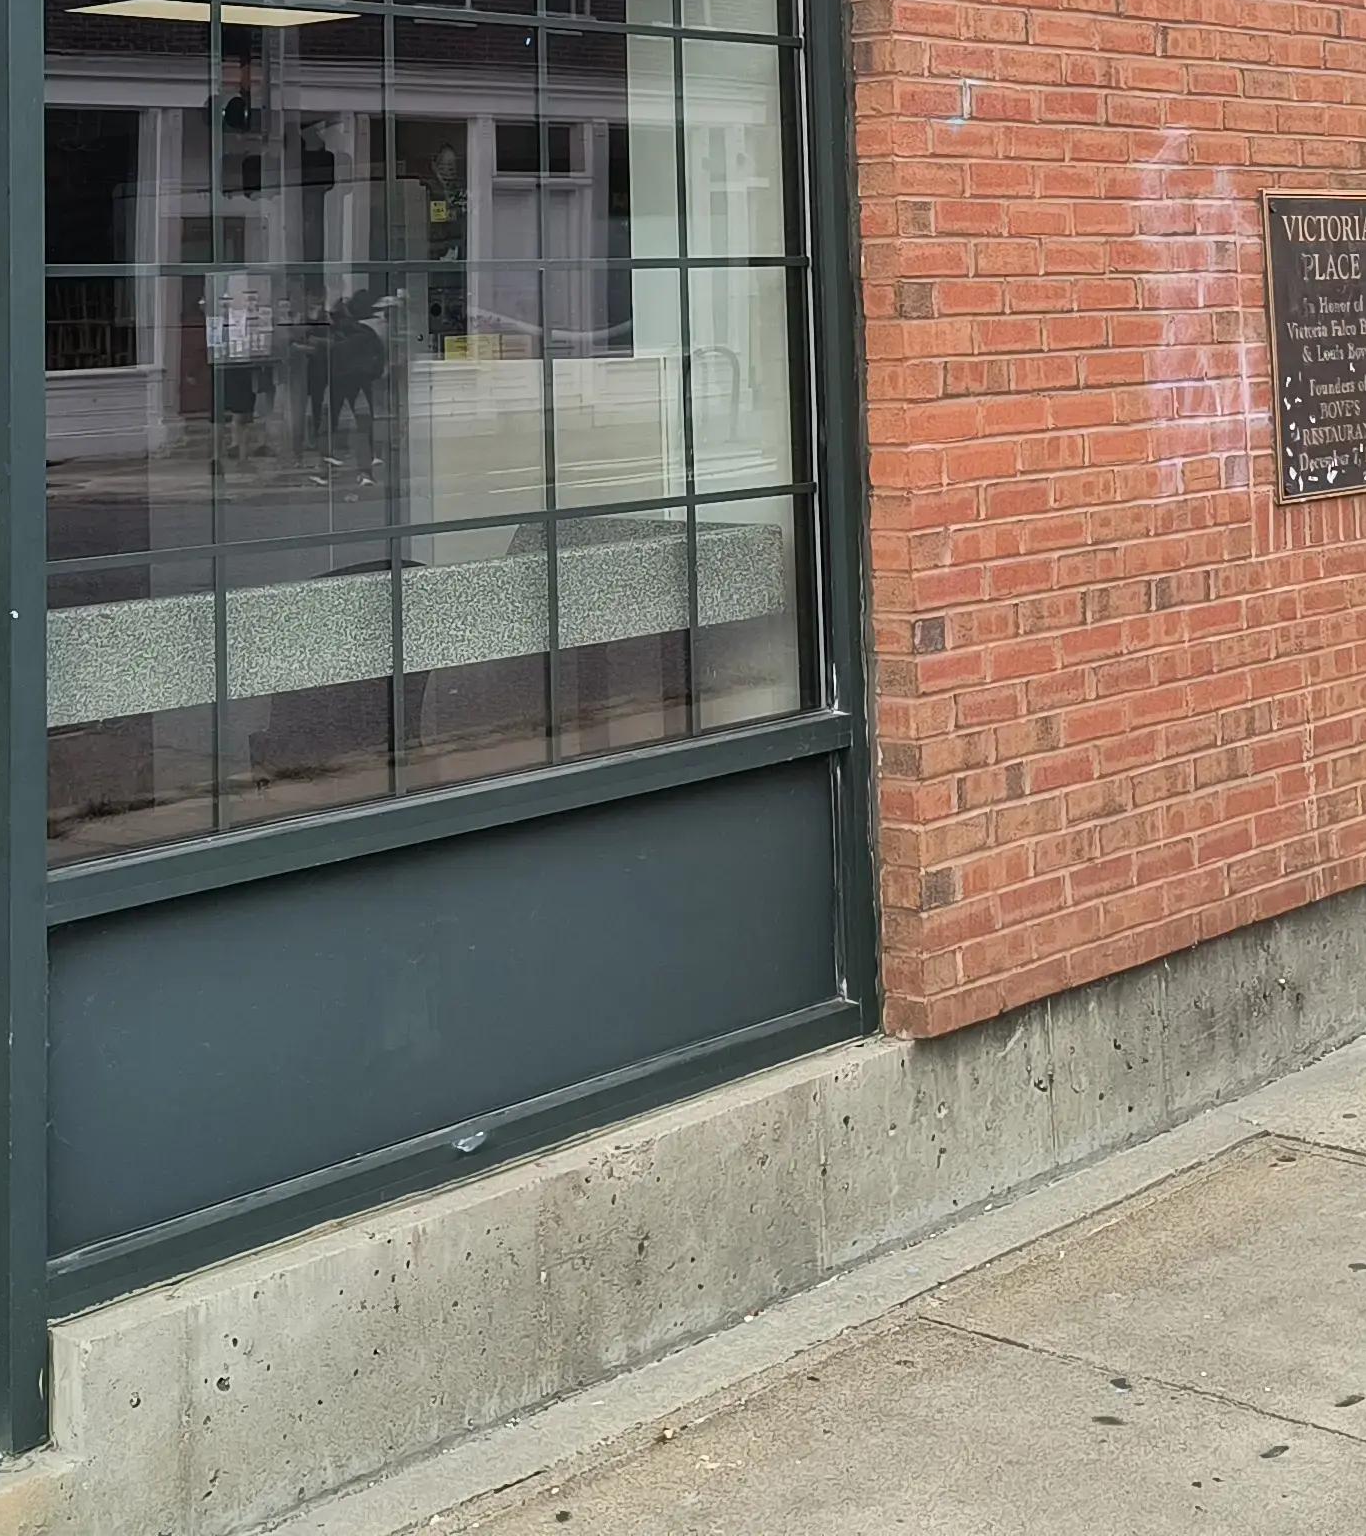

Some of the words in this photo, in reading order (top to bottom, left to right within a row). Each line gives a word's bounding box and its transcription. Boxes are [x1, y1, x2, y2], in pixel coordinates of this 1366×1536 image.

[1301, 252, 1362, 281] PLACE
[1318, 296, 1351, 314] Honor
[1354, 294, 1364, 313] of
[1286, 321, 1329, 342] Victoria
[1302, 345, 1314, 362] &
[1309, 376, 1356, 397] Founders
